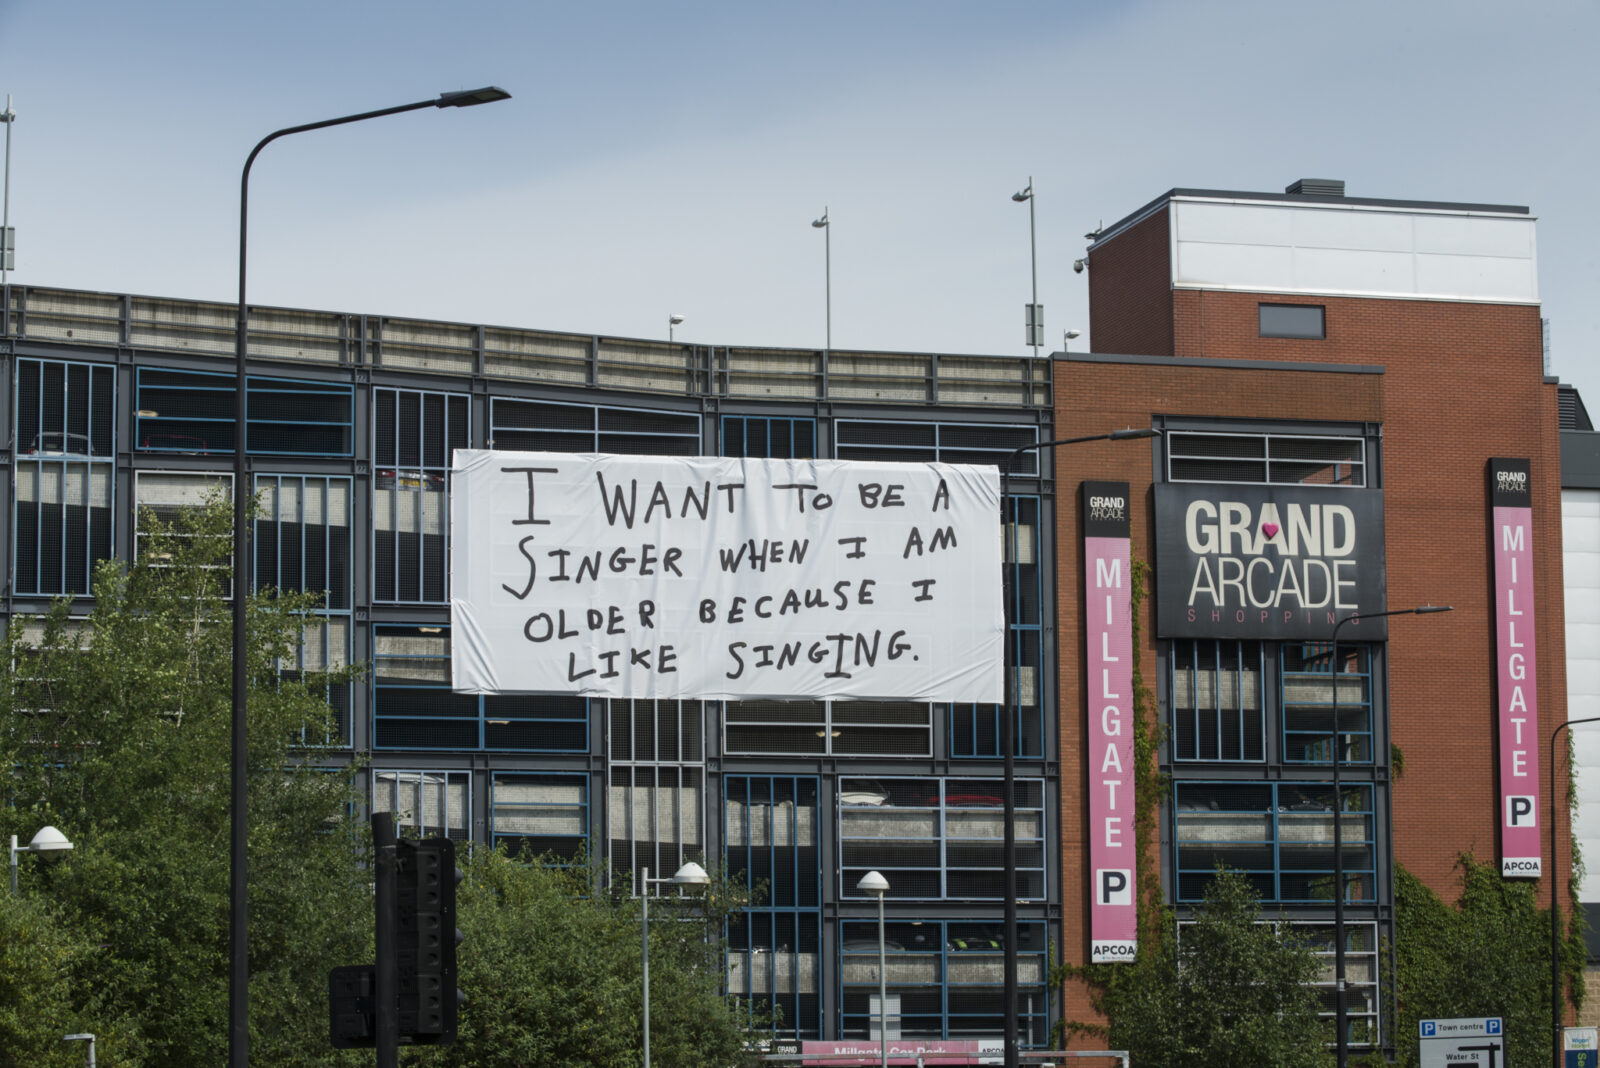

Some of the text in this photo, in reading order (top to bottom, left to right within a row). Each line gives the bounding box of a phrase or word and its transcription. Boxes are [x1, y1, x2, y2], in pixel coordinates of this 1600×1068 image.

[1496, 471, 1526, 481] GRAND
[501, 467, 559, 526] I
[597, 470, 745, 529] WANT
[858, 483, 905, 508] BE
[932, 479, 950, 512] A
[1090, 496, 1124, 508] GRAND
[1090, 507, 1124, 519] ARCADE
[1185, 500, 1356, 558] GRAND
[503, 526, 957, 600] SINGER WHEN I AM
[1188, 556, 1358, 609] ARCADE
[524, 579, 936, 642] OLDER BECAUSE I
[1187, 608, 1360, 625] SHOPPING
[568, 630, 919, 682] LIKE SINGING.
[1503, 525, 1527, 777] MILLGATE
[1096, 558, 1123, 847] MILLGATE
[1511, 797, 1531, 826] P
[1504, 861, 1539, 870] APCOA
[1102, 871, 1127, 904] P
[1093, 945, 1135, 955] APCOA
[1460, 1023, 1484, 1031] centre
[777, 1046, 798, 1054] GRAND
[1445, 1052, 1480, 1061] Water St
